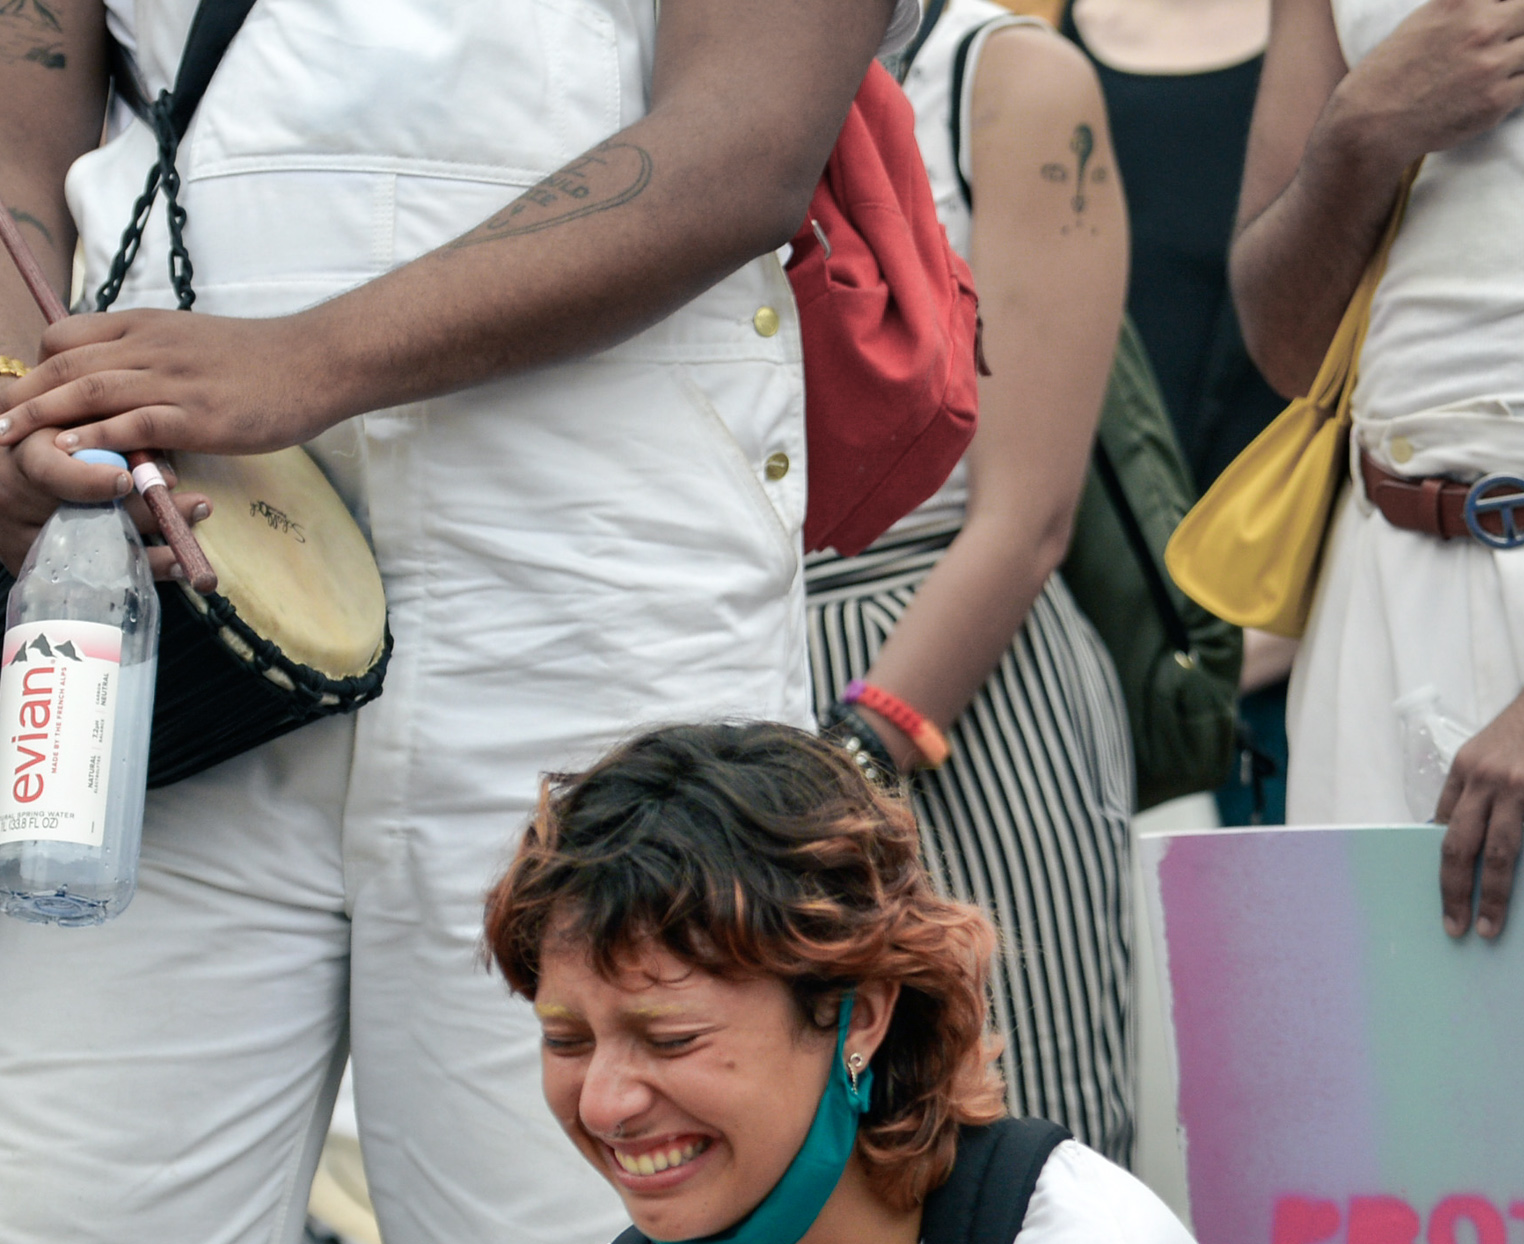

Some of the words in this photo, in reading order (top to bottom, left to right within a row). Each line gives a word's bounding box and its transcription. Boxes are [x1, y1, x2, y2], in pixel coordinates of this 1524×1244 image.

[100, 673, 109, 706] NEUTRAL
[56, 688, 65, 720] FRENCH
[11, 667, 55, 803] evian
[54, 722, 62, 737] THE
[53, 739, 60, 750] BY
[51, 752, 59, 774] MADE
[88, 755, 97, 788] NATURAL
[29, 817, 39, 829] FL
[42, 816, 59, 829] OZ)
[48, 811, 75, 819] WATER
